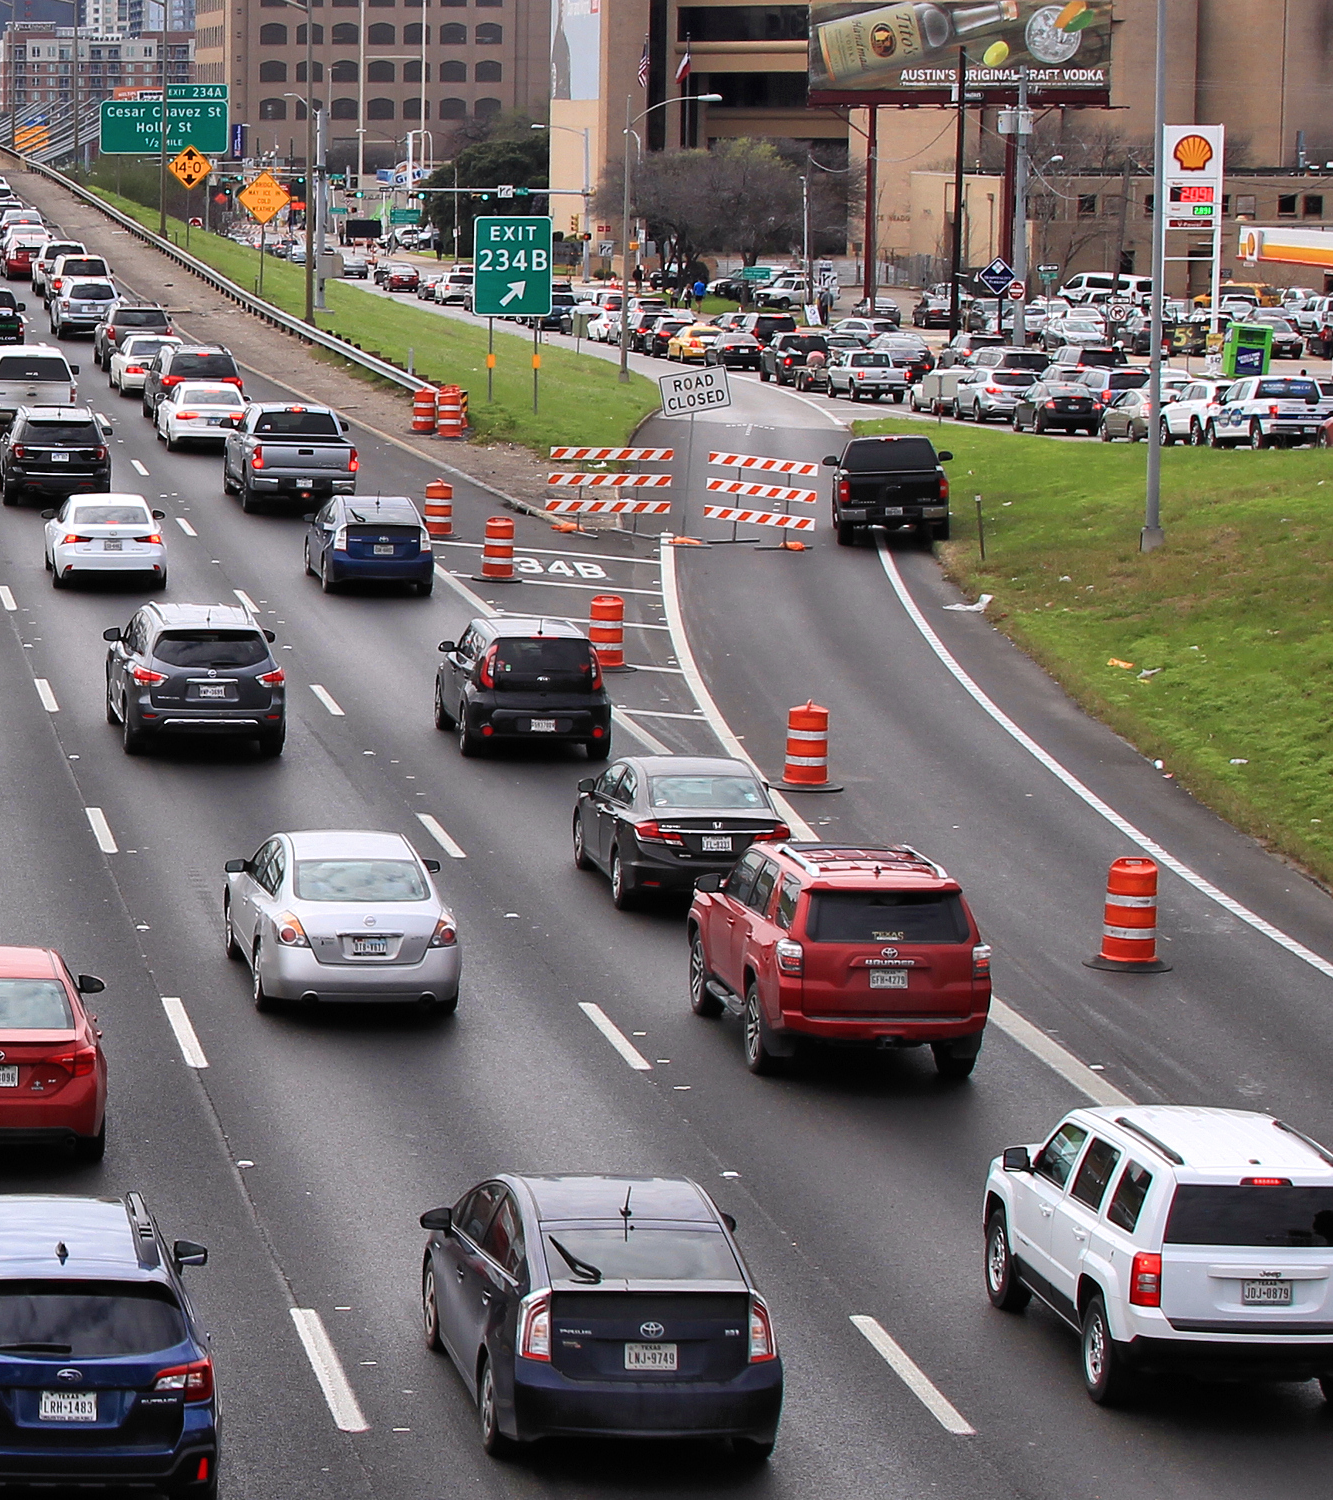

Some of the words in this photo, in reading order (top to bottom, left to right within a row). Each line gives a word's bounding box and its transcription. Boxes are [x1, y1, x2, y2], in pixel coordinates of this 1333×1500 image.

[900, 69, 956, 80] AUSTIN'S
[1063, 69, 1104, 80] VODKA
[168, 88, 186, 96] EXIT
[192, 87, 223, 98] 234A
[107, 106, 146, 118] Cesar
[207, 106, 222, 118] St
[178, 122, 192, 133] St
[144, 137, 159, 148] 1/2
[490, 226, 538, 241] EXIT
[478, 249, 548, 271] 234B
[672, 374, 714, 393] ROAD
[667, 389, 726, 411] CLOSED
[871, 931, 904, 940] TEXAS
[1259, 1270, 1282, 1279] Jeep
